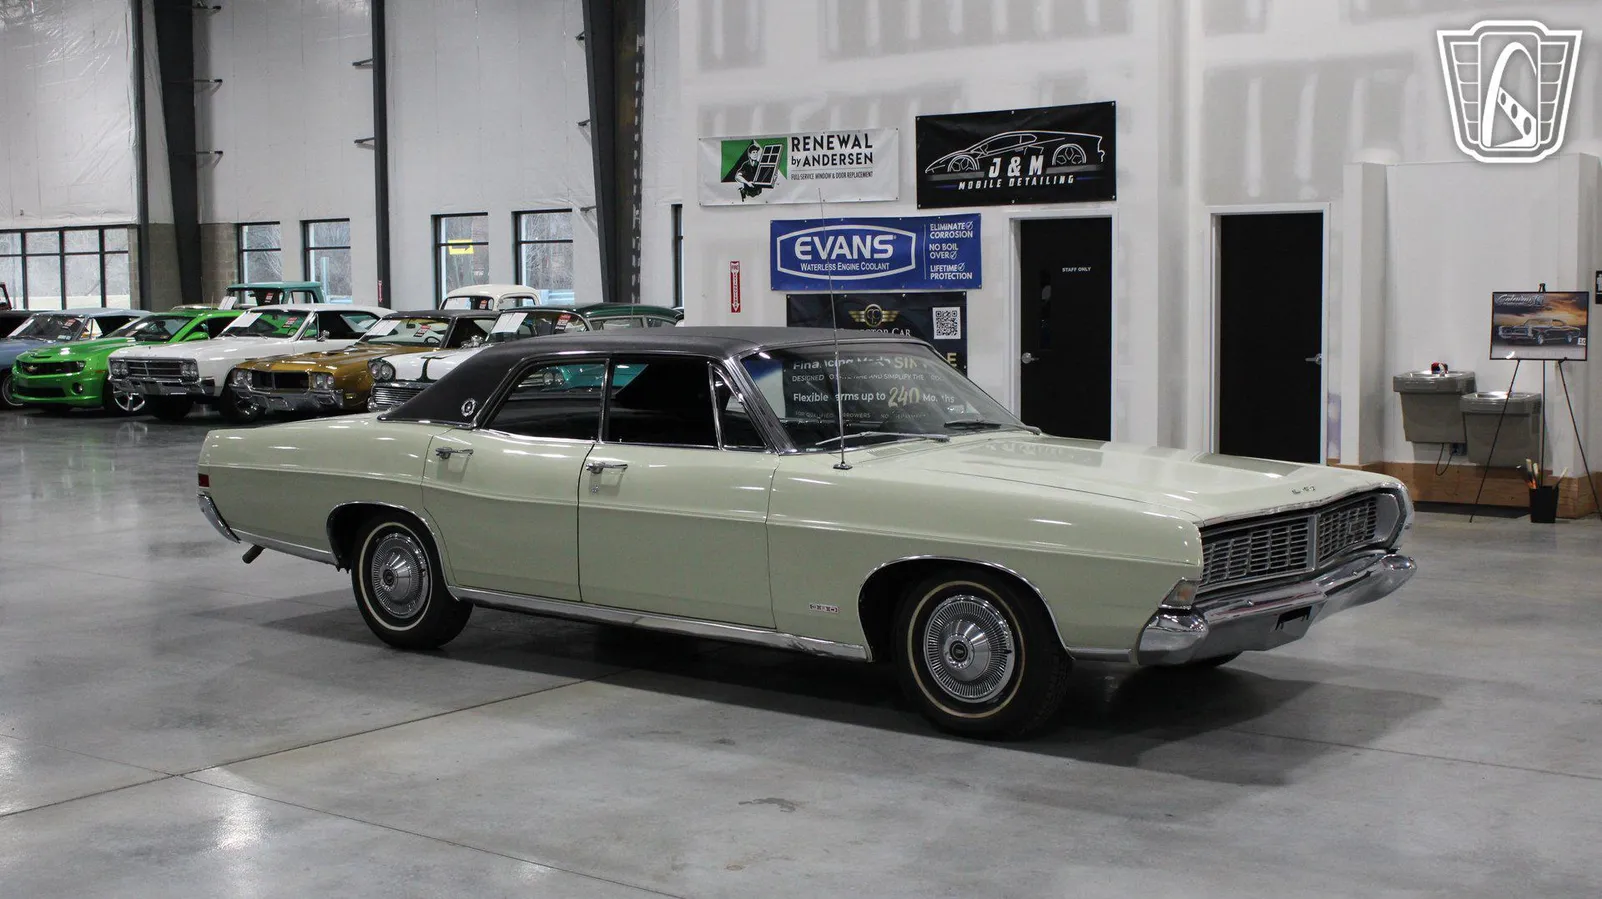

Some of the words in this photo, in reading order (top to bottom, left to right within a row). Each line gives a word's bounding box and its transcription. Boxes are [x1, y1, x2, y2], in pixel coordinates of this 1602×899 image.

[791, 133, 873, 152] RENEWAL
[791, 156, 801, 167] by
[802, 152, 873, 167] ANDERSEN
[988, 157, 1001, 178] J
[1007, 156, 1021, 177] &
[1028, 155, 1044, 176] M
[958, 179, 1002, 190] MOBILE
[1009, 175, 1074, 187] DETAILING
[930, 223, 965, 231] ELIMINATE
[930, 231, 973, 239] CORROSION
[794, 235, 894, 260] EVANS
[929, 243, 940, 251] NO
[942, 243, 958, 251] BOIL
[930, 251, 949, 259] OVER
[930, 264, 957, 272] LIFETIME
[930, 272, 973, 280] PROTECTION
[793, 392, 828, 402] Flexible
[861, 393, 873, 403] up
[876, 392, 885, 401] to
[888, 386, 920, 407] 240
